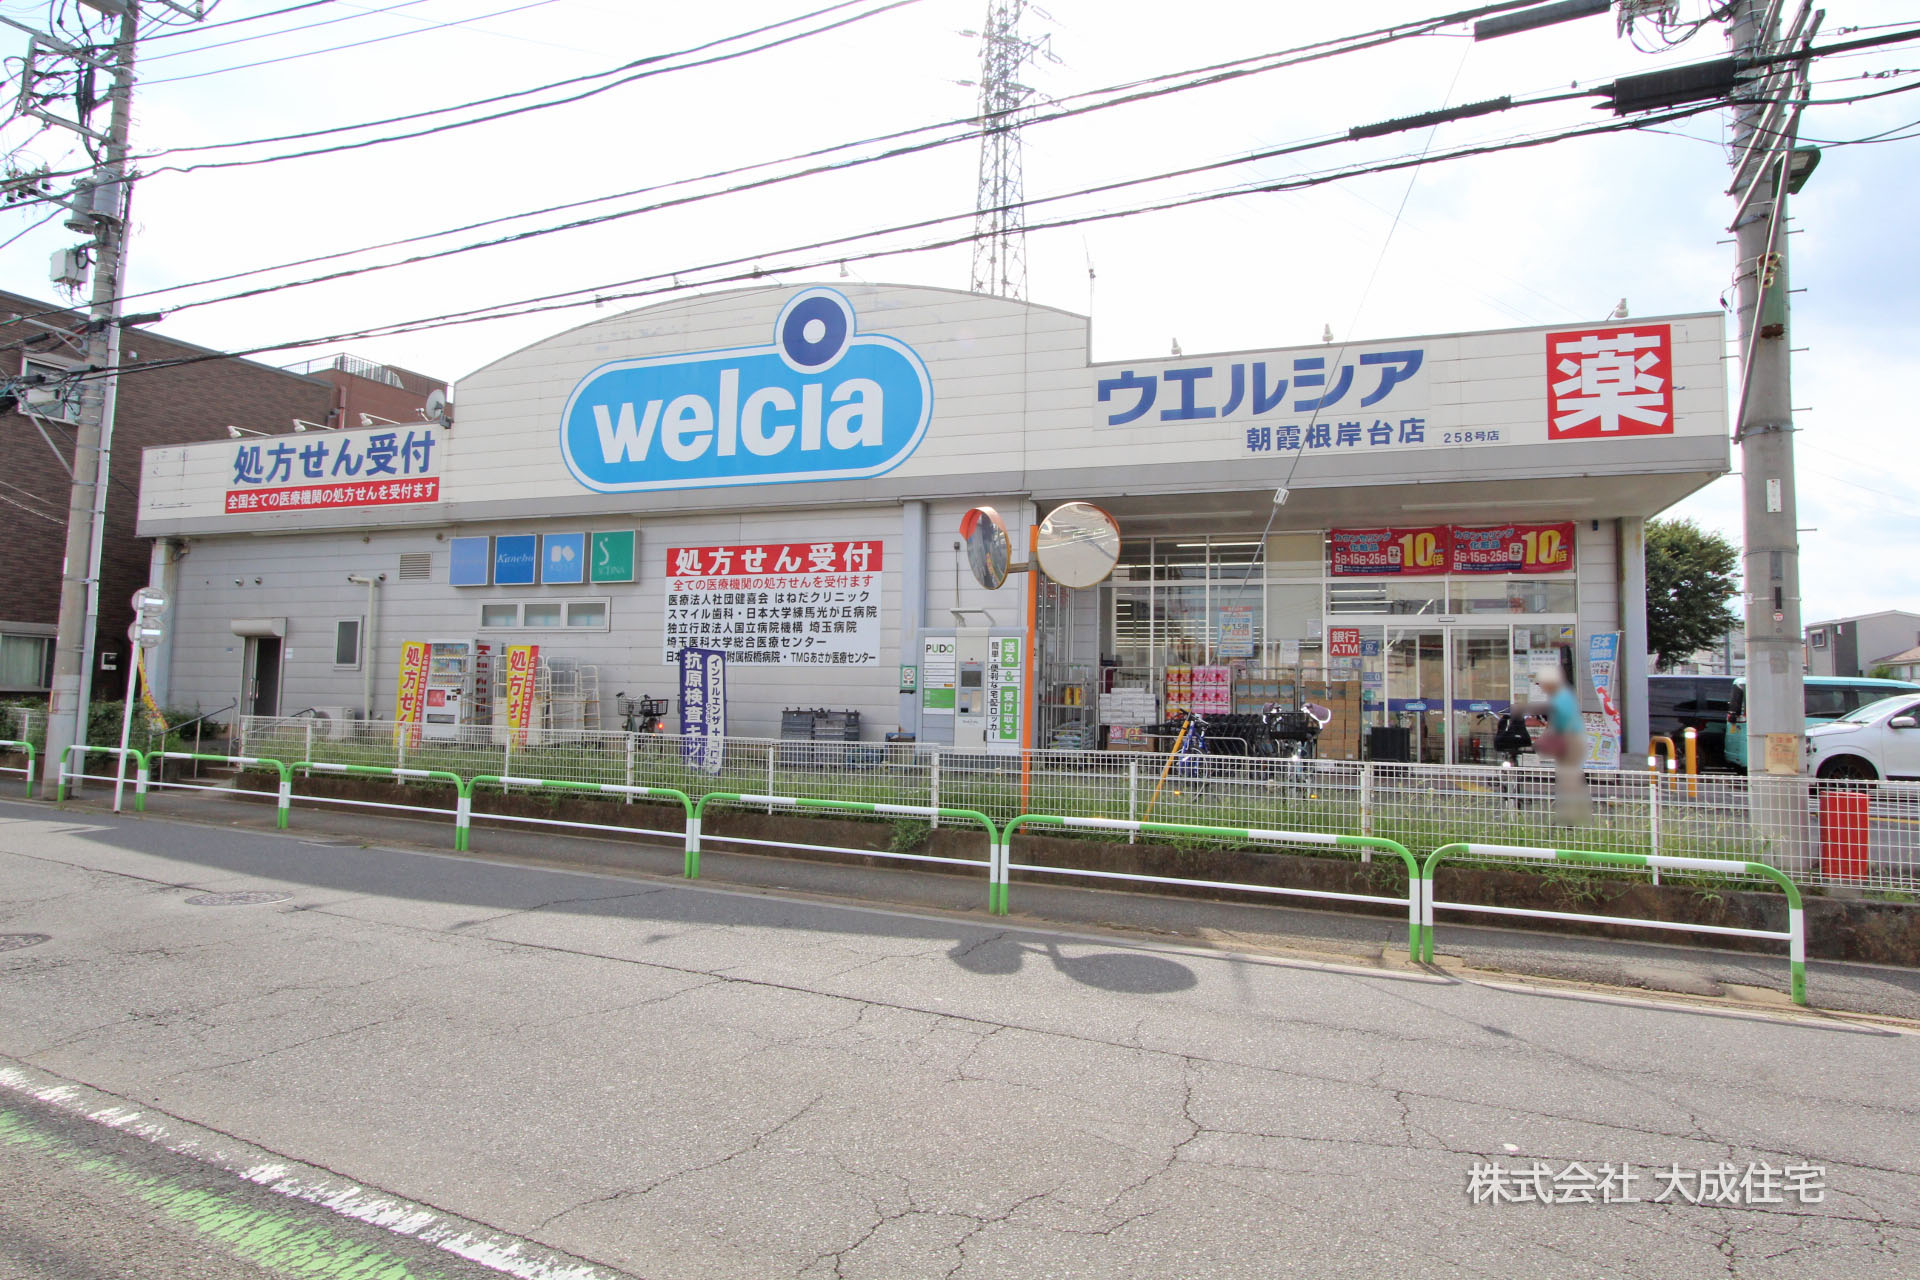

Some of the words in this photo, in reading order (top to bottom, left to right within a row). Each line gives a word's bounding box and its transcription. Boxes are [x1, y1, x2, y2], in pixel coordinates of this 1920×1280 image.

[1097, 349, 1425, 426] ウエルシア
[1550, 333, 1668, 432] 薬
[593, 335, 883, 464] welcia
[1246, 418, 1425, 453] 朝霞根岸台店
[1443, 430, 1500, 444] 258号店
[233, 430, 436, 485] 処方せん受付
[227, 481, 436, 510] 全国全ての医療機関の処方せんを受付ます
[675, 542, 873, 576] 処方せん受付
[672, 574, 874, 592] 全ての医療機関の処方せんを受付ます
[668, 592, 769, 606] 医療法人社団健喜会
[775, 591, 870, 604] はねだクリニック
[668, 605, 878, 620] スマイル歯科・日本大学練馬光が丘病院
[667, 621, 803, 635] 独立行政法人国立病院機構
[809, 621, 857, 634] 埼玉病院
[667, 635, 827, 648] 埼玉医科大学総合医療センター
[1332, 631, 1357, 643] 銀行
[925, 644, 954, 654] PUDO
[1331, 643, 1358, 654] ATM
